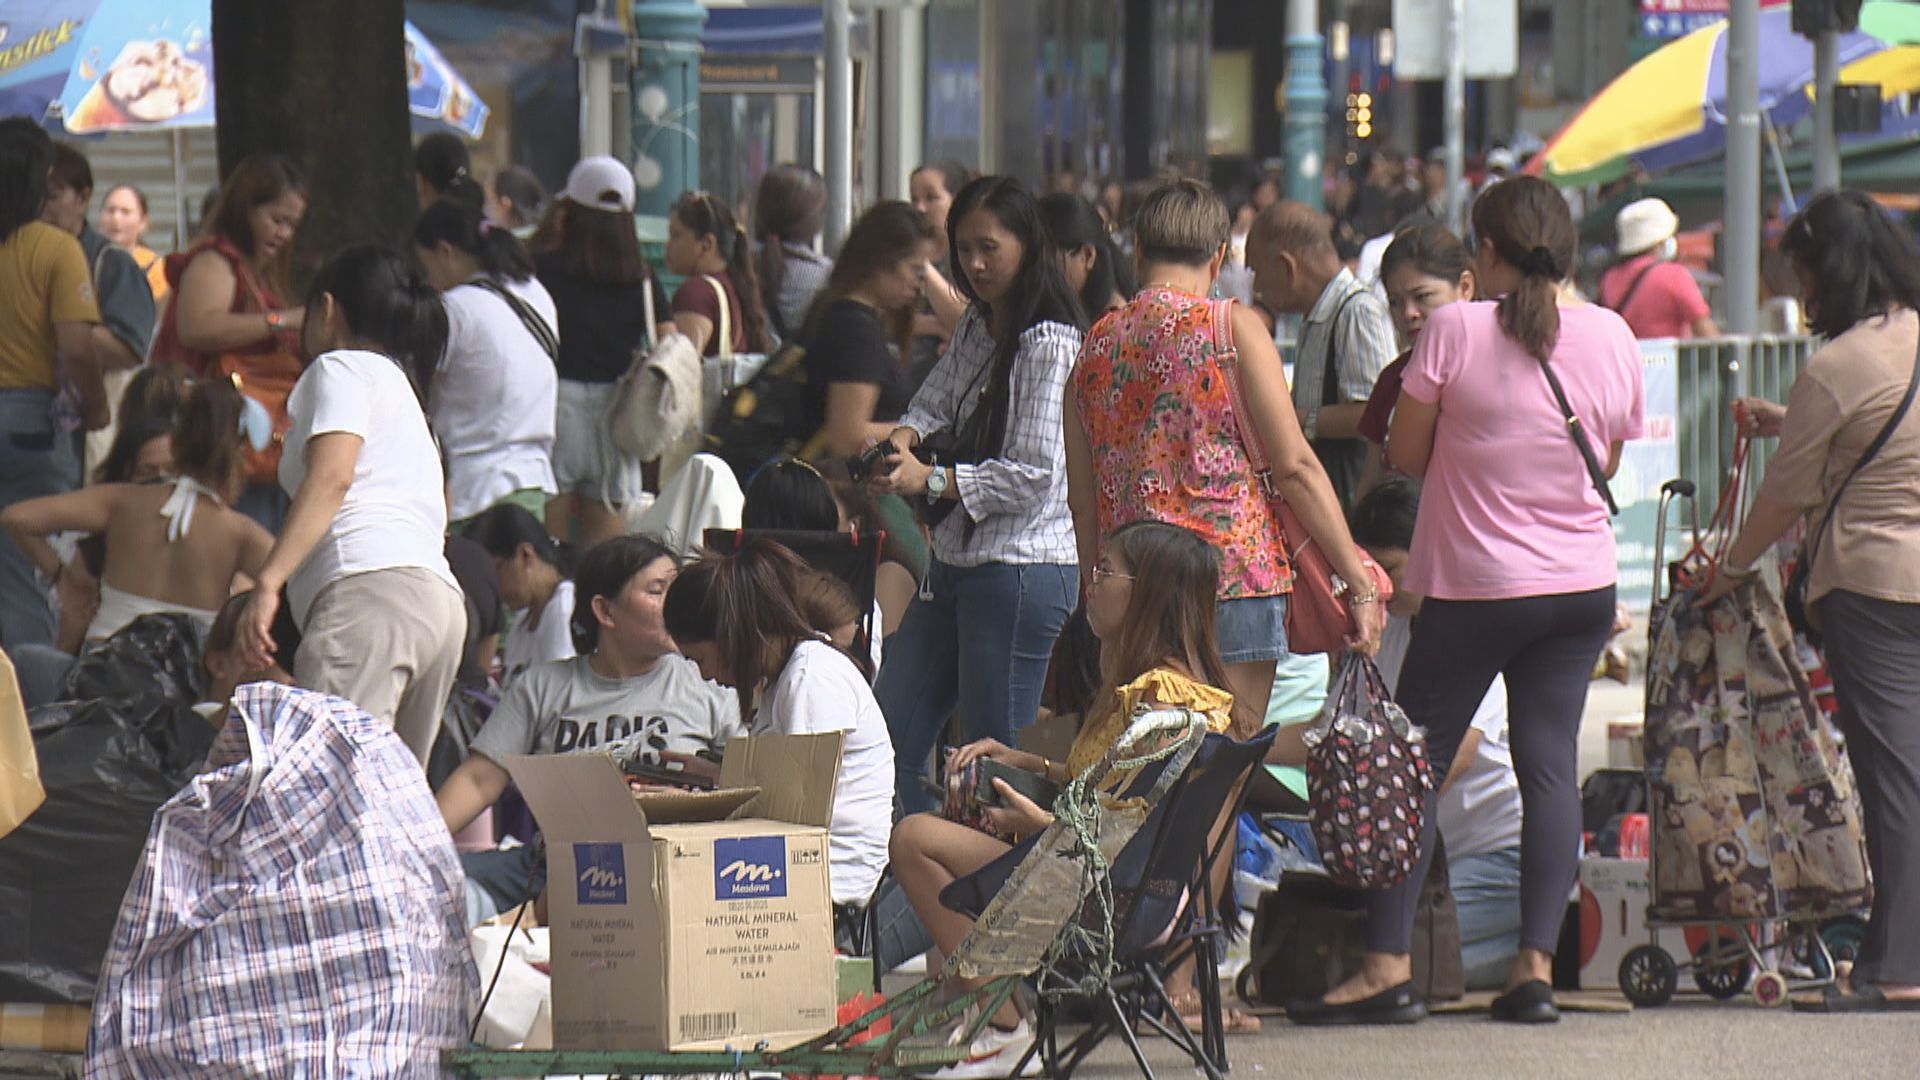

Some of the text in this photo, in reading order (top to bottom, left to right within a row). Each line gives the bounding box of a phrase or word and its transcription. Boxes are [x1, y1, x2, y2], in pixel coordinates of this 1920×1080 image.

[732, 882, 770, 894] Meadows
[705, 911, 799, 927] NATURAL MINERAL
[735, 928, 769, 940] WATER
